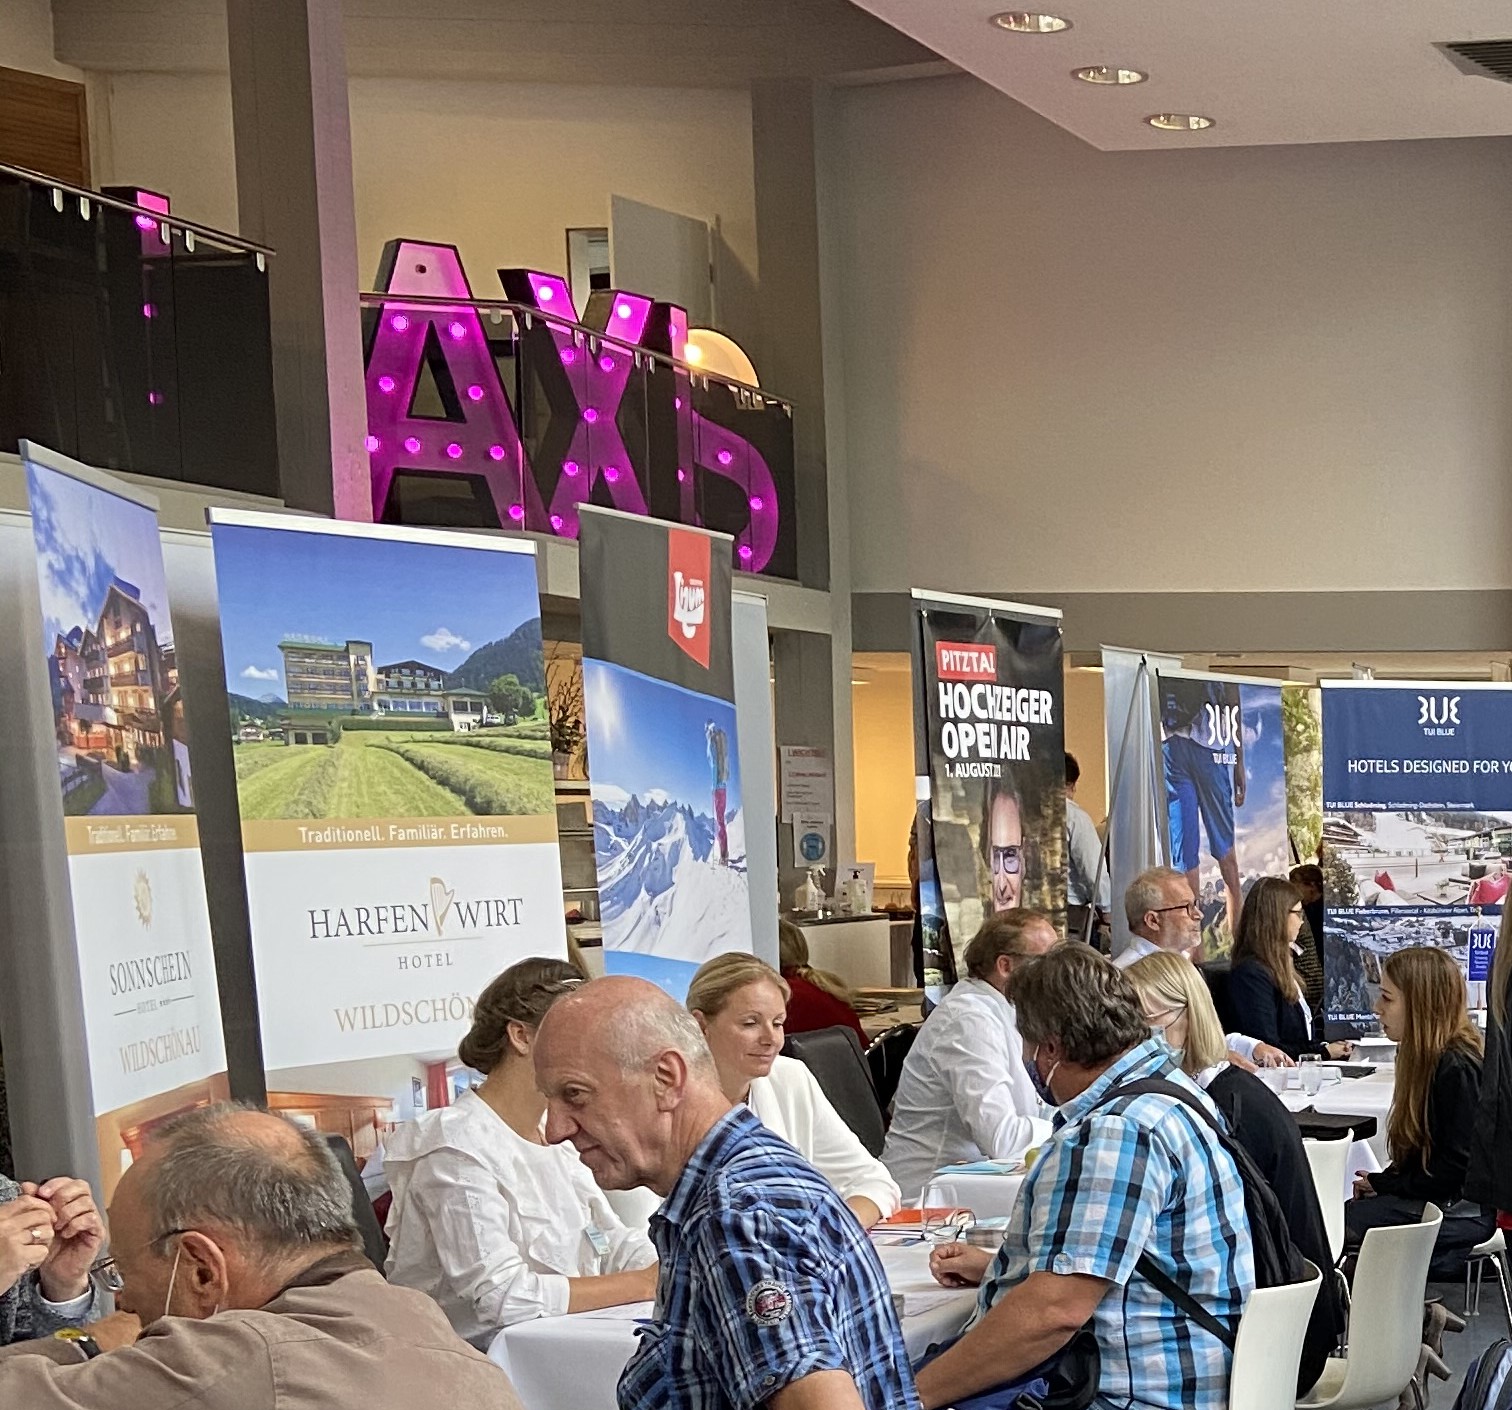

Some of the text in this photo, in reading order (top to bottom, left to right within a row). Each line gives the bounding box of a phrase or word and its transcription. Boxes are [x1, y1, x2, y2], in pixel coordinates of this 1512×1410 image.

[941, 649, 995, 674] PITZTAL
[938, 682, 1053, 724] HOCHZEIGER
[1000, 725, 1031, 761] AIR
[1423, 727, 1455, 736] TUI BLUE
[945, 763, 954, 777] 1.
[955, 763, 994, 778] AUGUST
[1348, 760, 1399, 773] HOTELS
[1403, 760, 1469, 774] DESIGNED
[1473, 761, 1499, 773] FOR
[298, 823, 509, 844] Traditionell. Familiär. Erfahren.
[308, 898, 524, 939] HARFEN WIRT
[110, 950, 192, 996] SONNSCHEIN
[398, 952, 453, 970] HOTEL
[333, 993, 478, 1033] WILDSCHÖN
[119, 1024, 200, 1074] WILDSCHÖNAU
